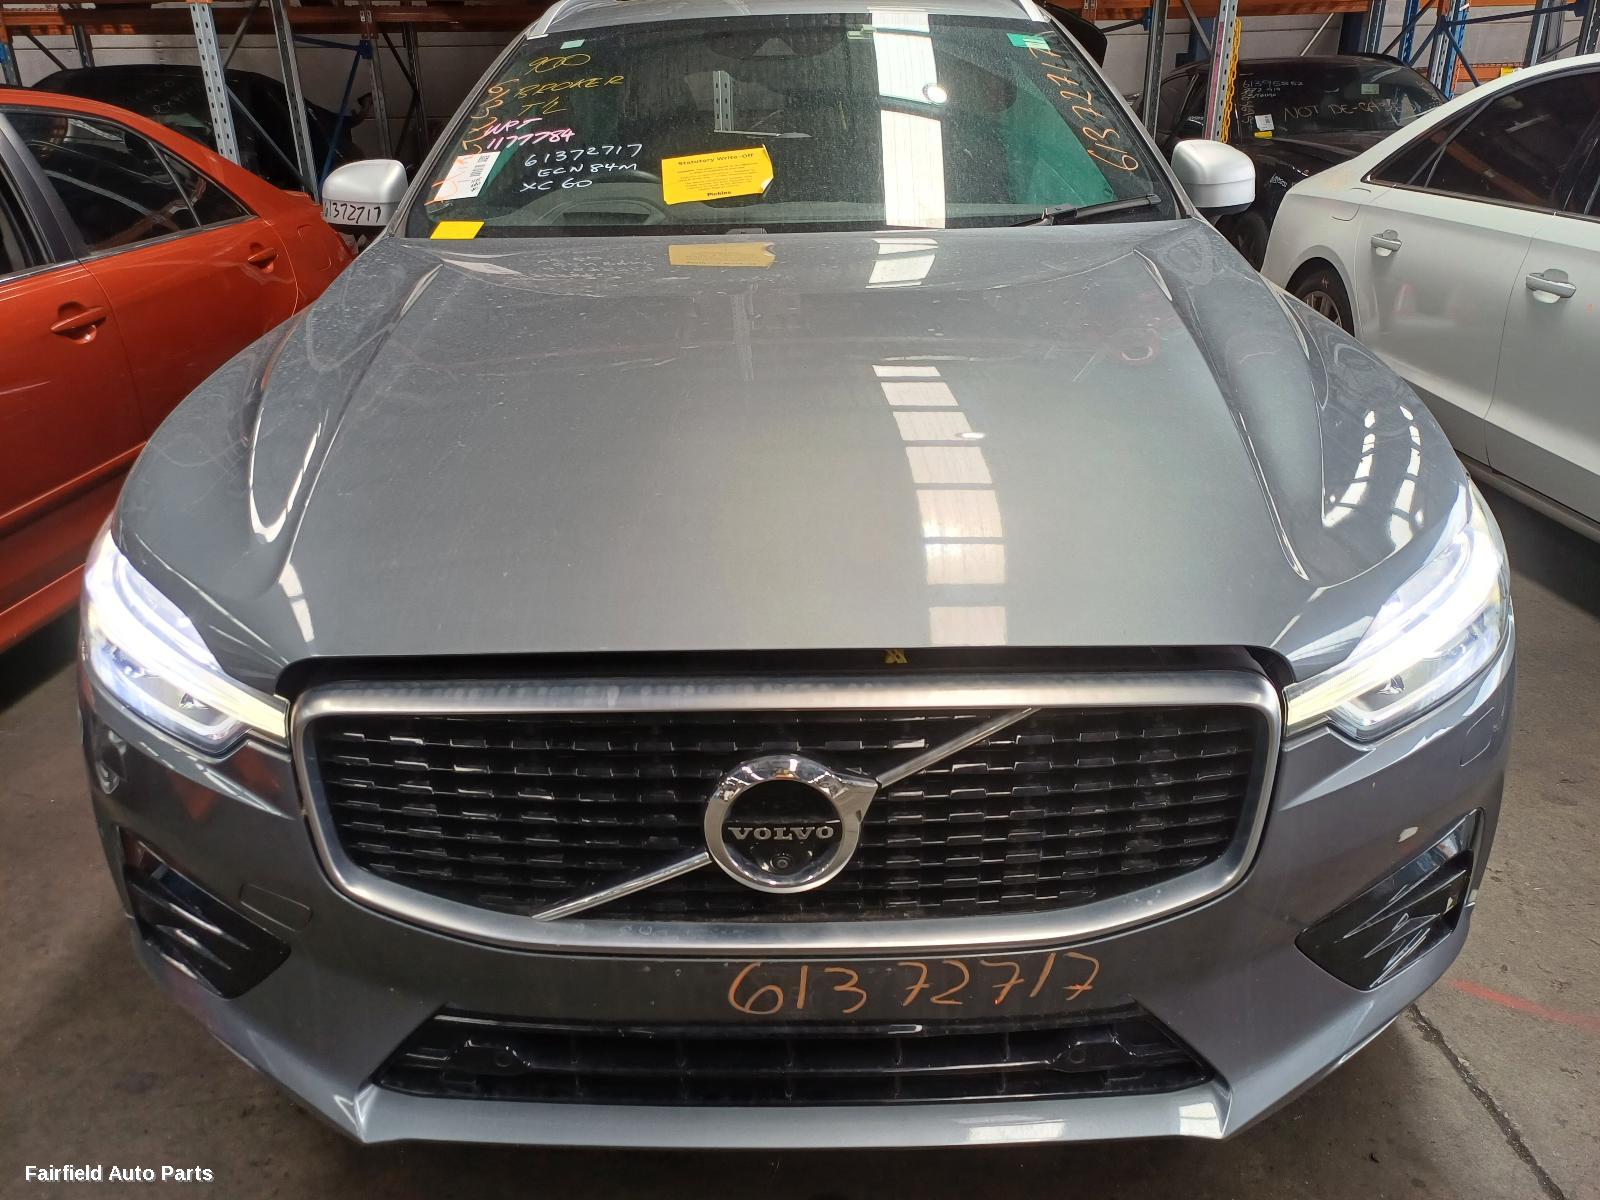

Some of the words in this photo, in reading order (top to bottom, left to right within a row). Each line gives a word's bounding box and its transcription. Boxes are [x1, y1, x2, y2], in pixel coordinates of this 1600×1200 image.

[514, 76, 624, 99] BROKER
[487, 128, 575, 150] 1177784
[524, 143, 643, 167] 61372717
[728, 826, 834, 841] VOLVO
